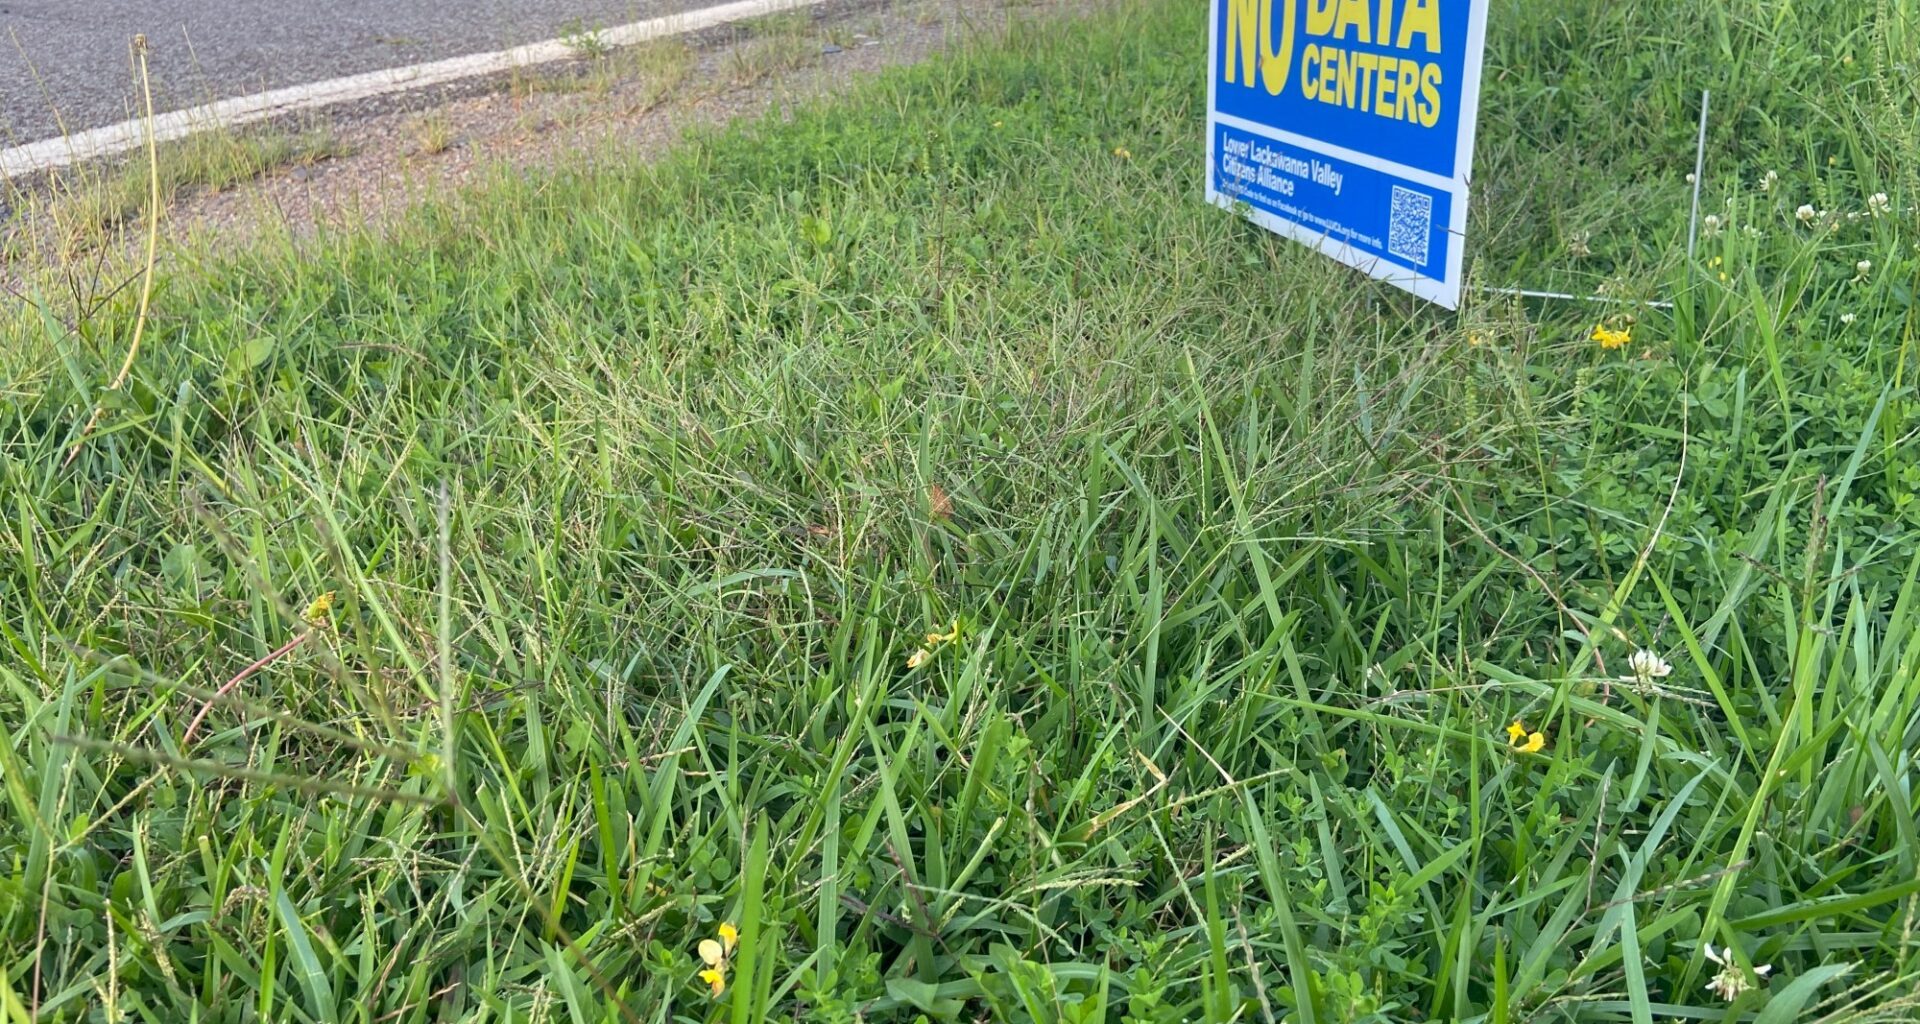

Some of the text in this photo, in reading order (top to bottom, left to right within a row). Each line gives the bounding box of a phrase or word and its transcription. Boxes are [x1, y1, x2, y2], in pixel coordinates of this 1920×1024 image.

[1225, 0, 1295, 96] NO
[1305, 0, 1441, 54] DATA
[1301, 43, 1442, 128] CENTERS
[1223, 131, 1343, 196] Lower Lackawanna Valley
[1223, 153, 1257, 182] Citizens
[1257, 165, 1294, 197] Alliance
